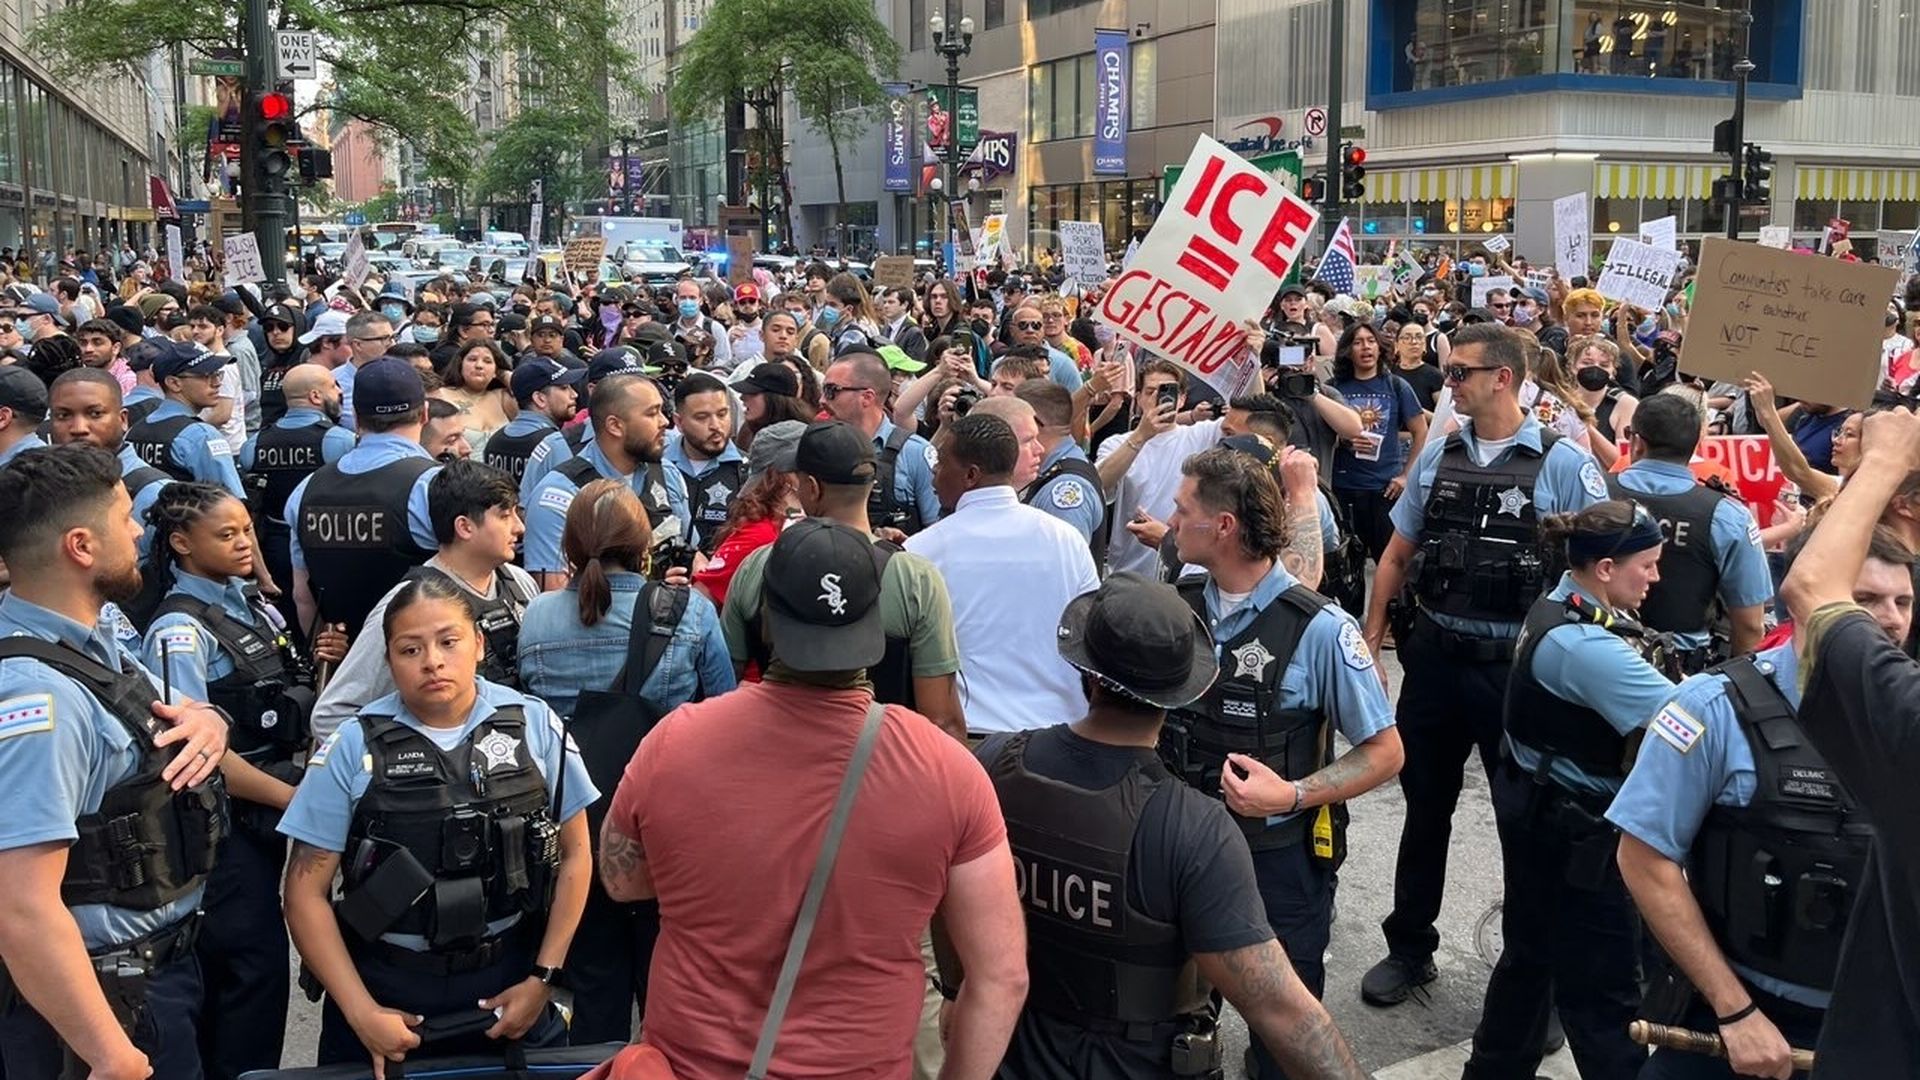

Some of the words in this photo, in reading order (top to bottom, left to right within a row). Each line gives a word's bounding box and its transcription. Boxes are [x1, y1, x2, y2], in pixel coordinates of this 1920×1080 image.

[281, 35, 310, 47] ONE
[281, 48, 310, 59] WAY
[1103, 51, 1120, 139] CHAMPS
[890, 99, 904, 166] CHAMPS
[1184, 155, 1313, 279] ICE
[232, 258, 258, 280] ICE
[1614, 263, 1669, 290] ILLEGAL
[1102, 270, 1249, 375] GESTAPO
[1720, 323, 1760, 346] NOT
[1775, 331, 1821, 358] ICE
[258, 447, 317, 466] POLICE
[1702, 439, 1783, 482] RICA
[306, 512, 384, 542] POLICE
[398, 751, 425, 760] LANDA
[1013, 855, 1113, 928] OLICE
